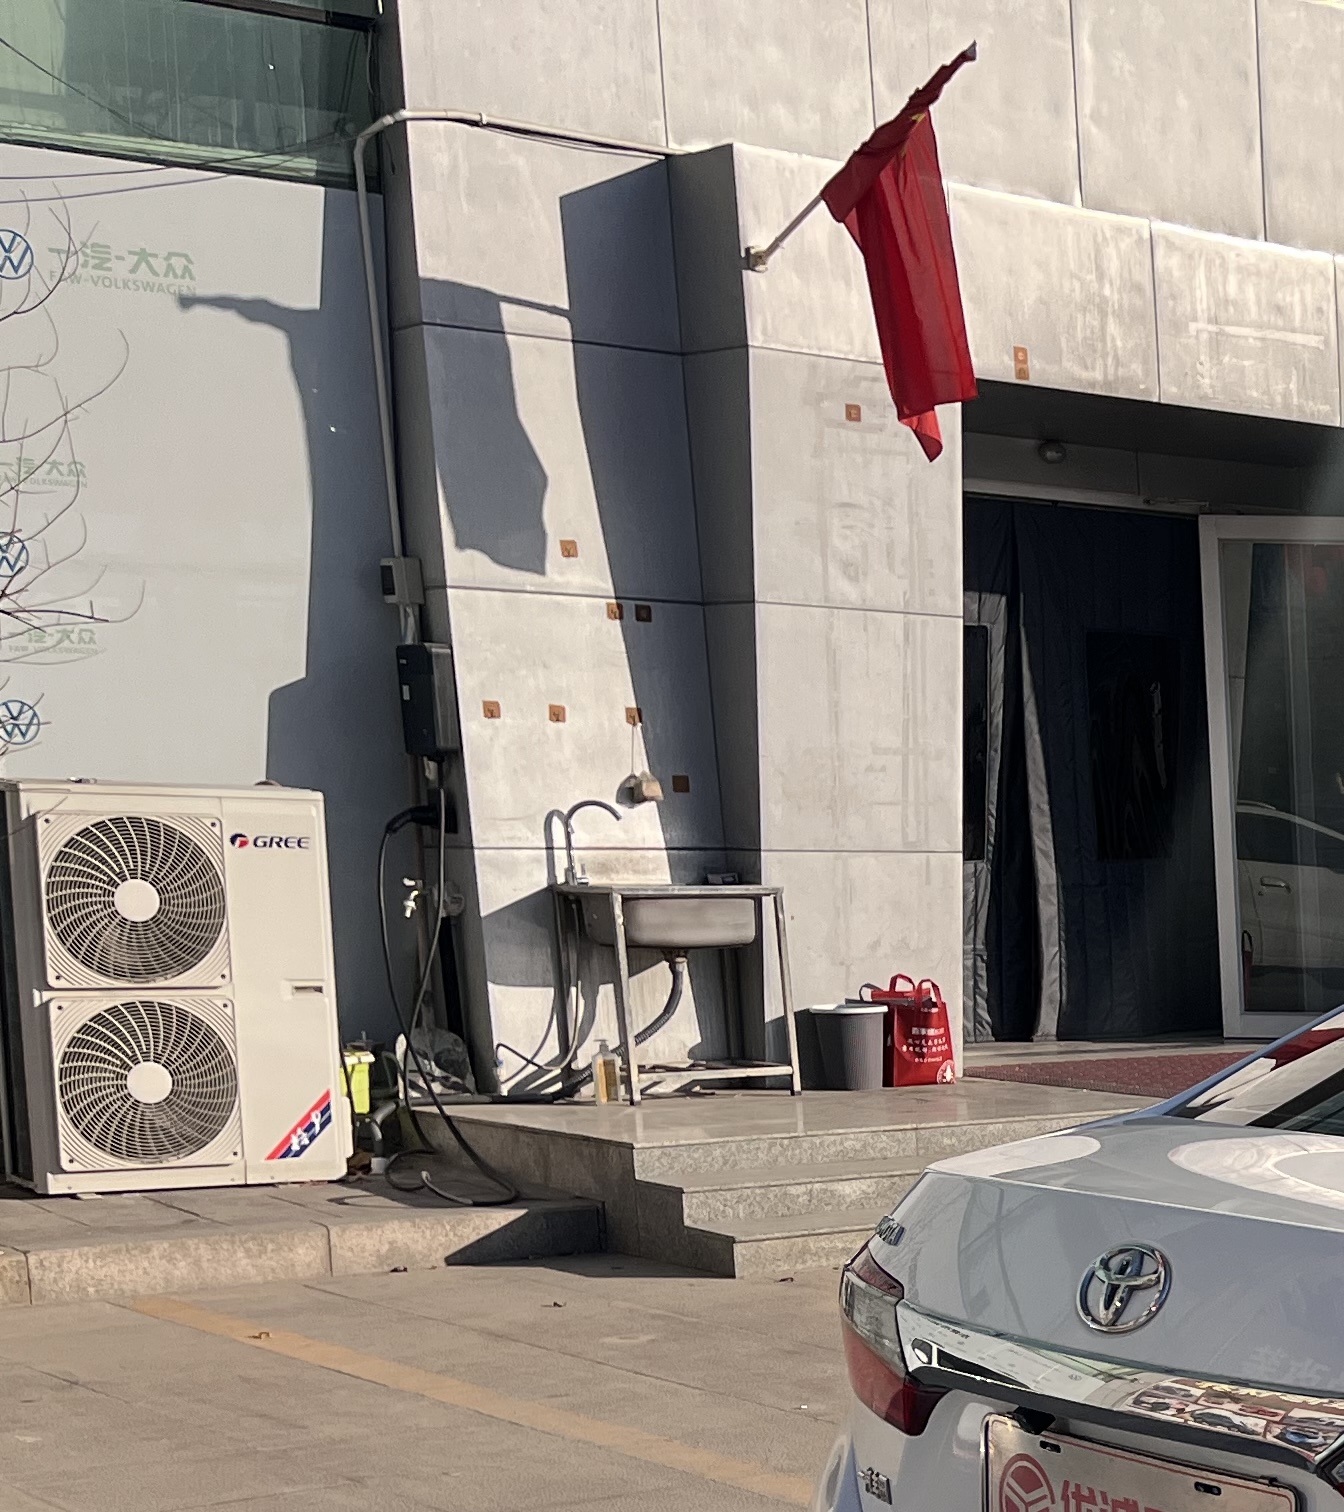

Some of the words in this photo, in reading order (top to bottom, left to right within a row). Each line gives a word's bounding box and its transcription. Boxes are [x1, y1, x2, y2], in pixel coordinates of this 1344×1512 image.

[0, 457, 87, 479] 一汽大众
[253, 836, 310, 850] GREE
